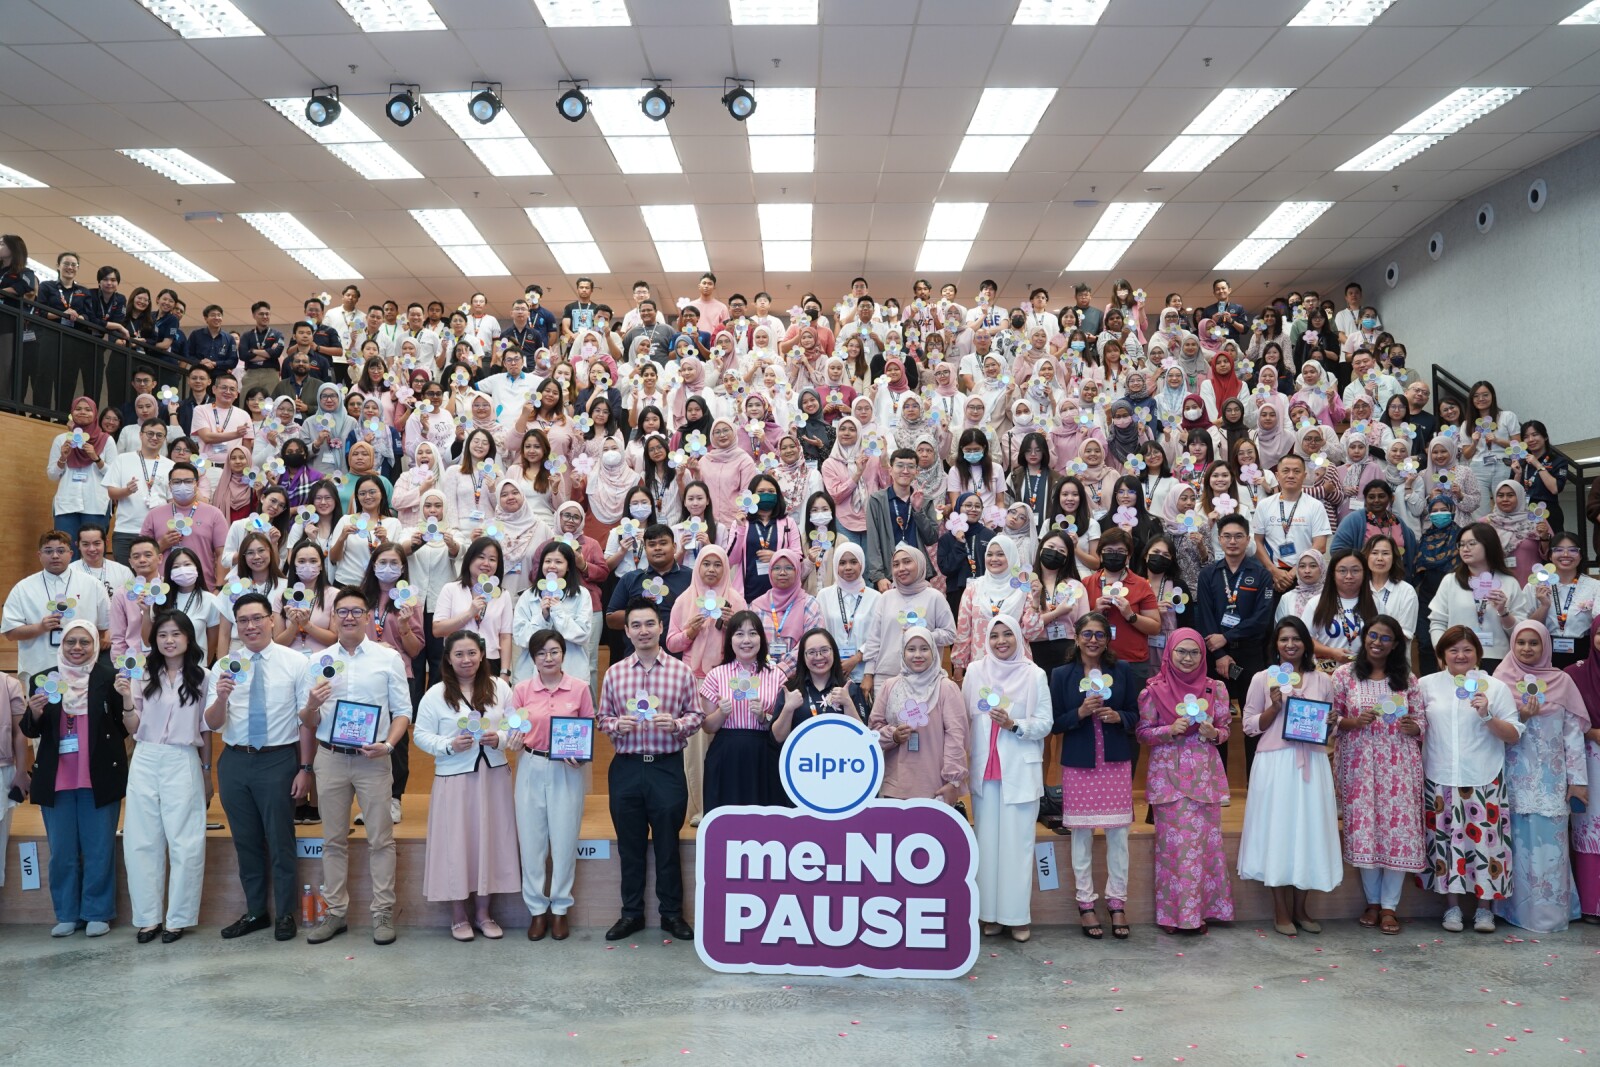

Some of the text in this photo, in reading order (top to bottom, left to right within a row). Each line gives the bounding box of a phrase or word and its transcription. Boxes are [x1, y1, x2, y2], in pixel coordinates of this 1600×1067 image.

[798, 753, 865, 779] alpro
[304, 845, 323, 855] VIP
[577, 847, 596, 856] VIP
[726, 832, 946, 885] me.NO
[23, 856, 32, 876] VIP
[1039, 856, 1049, 876] VIP
[724, 893, 946, 949] PAUSE
